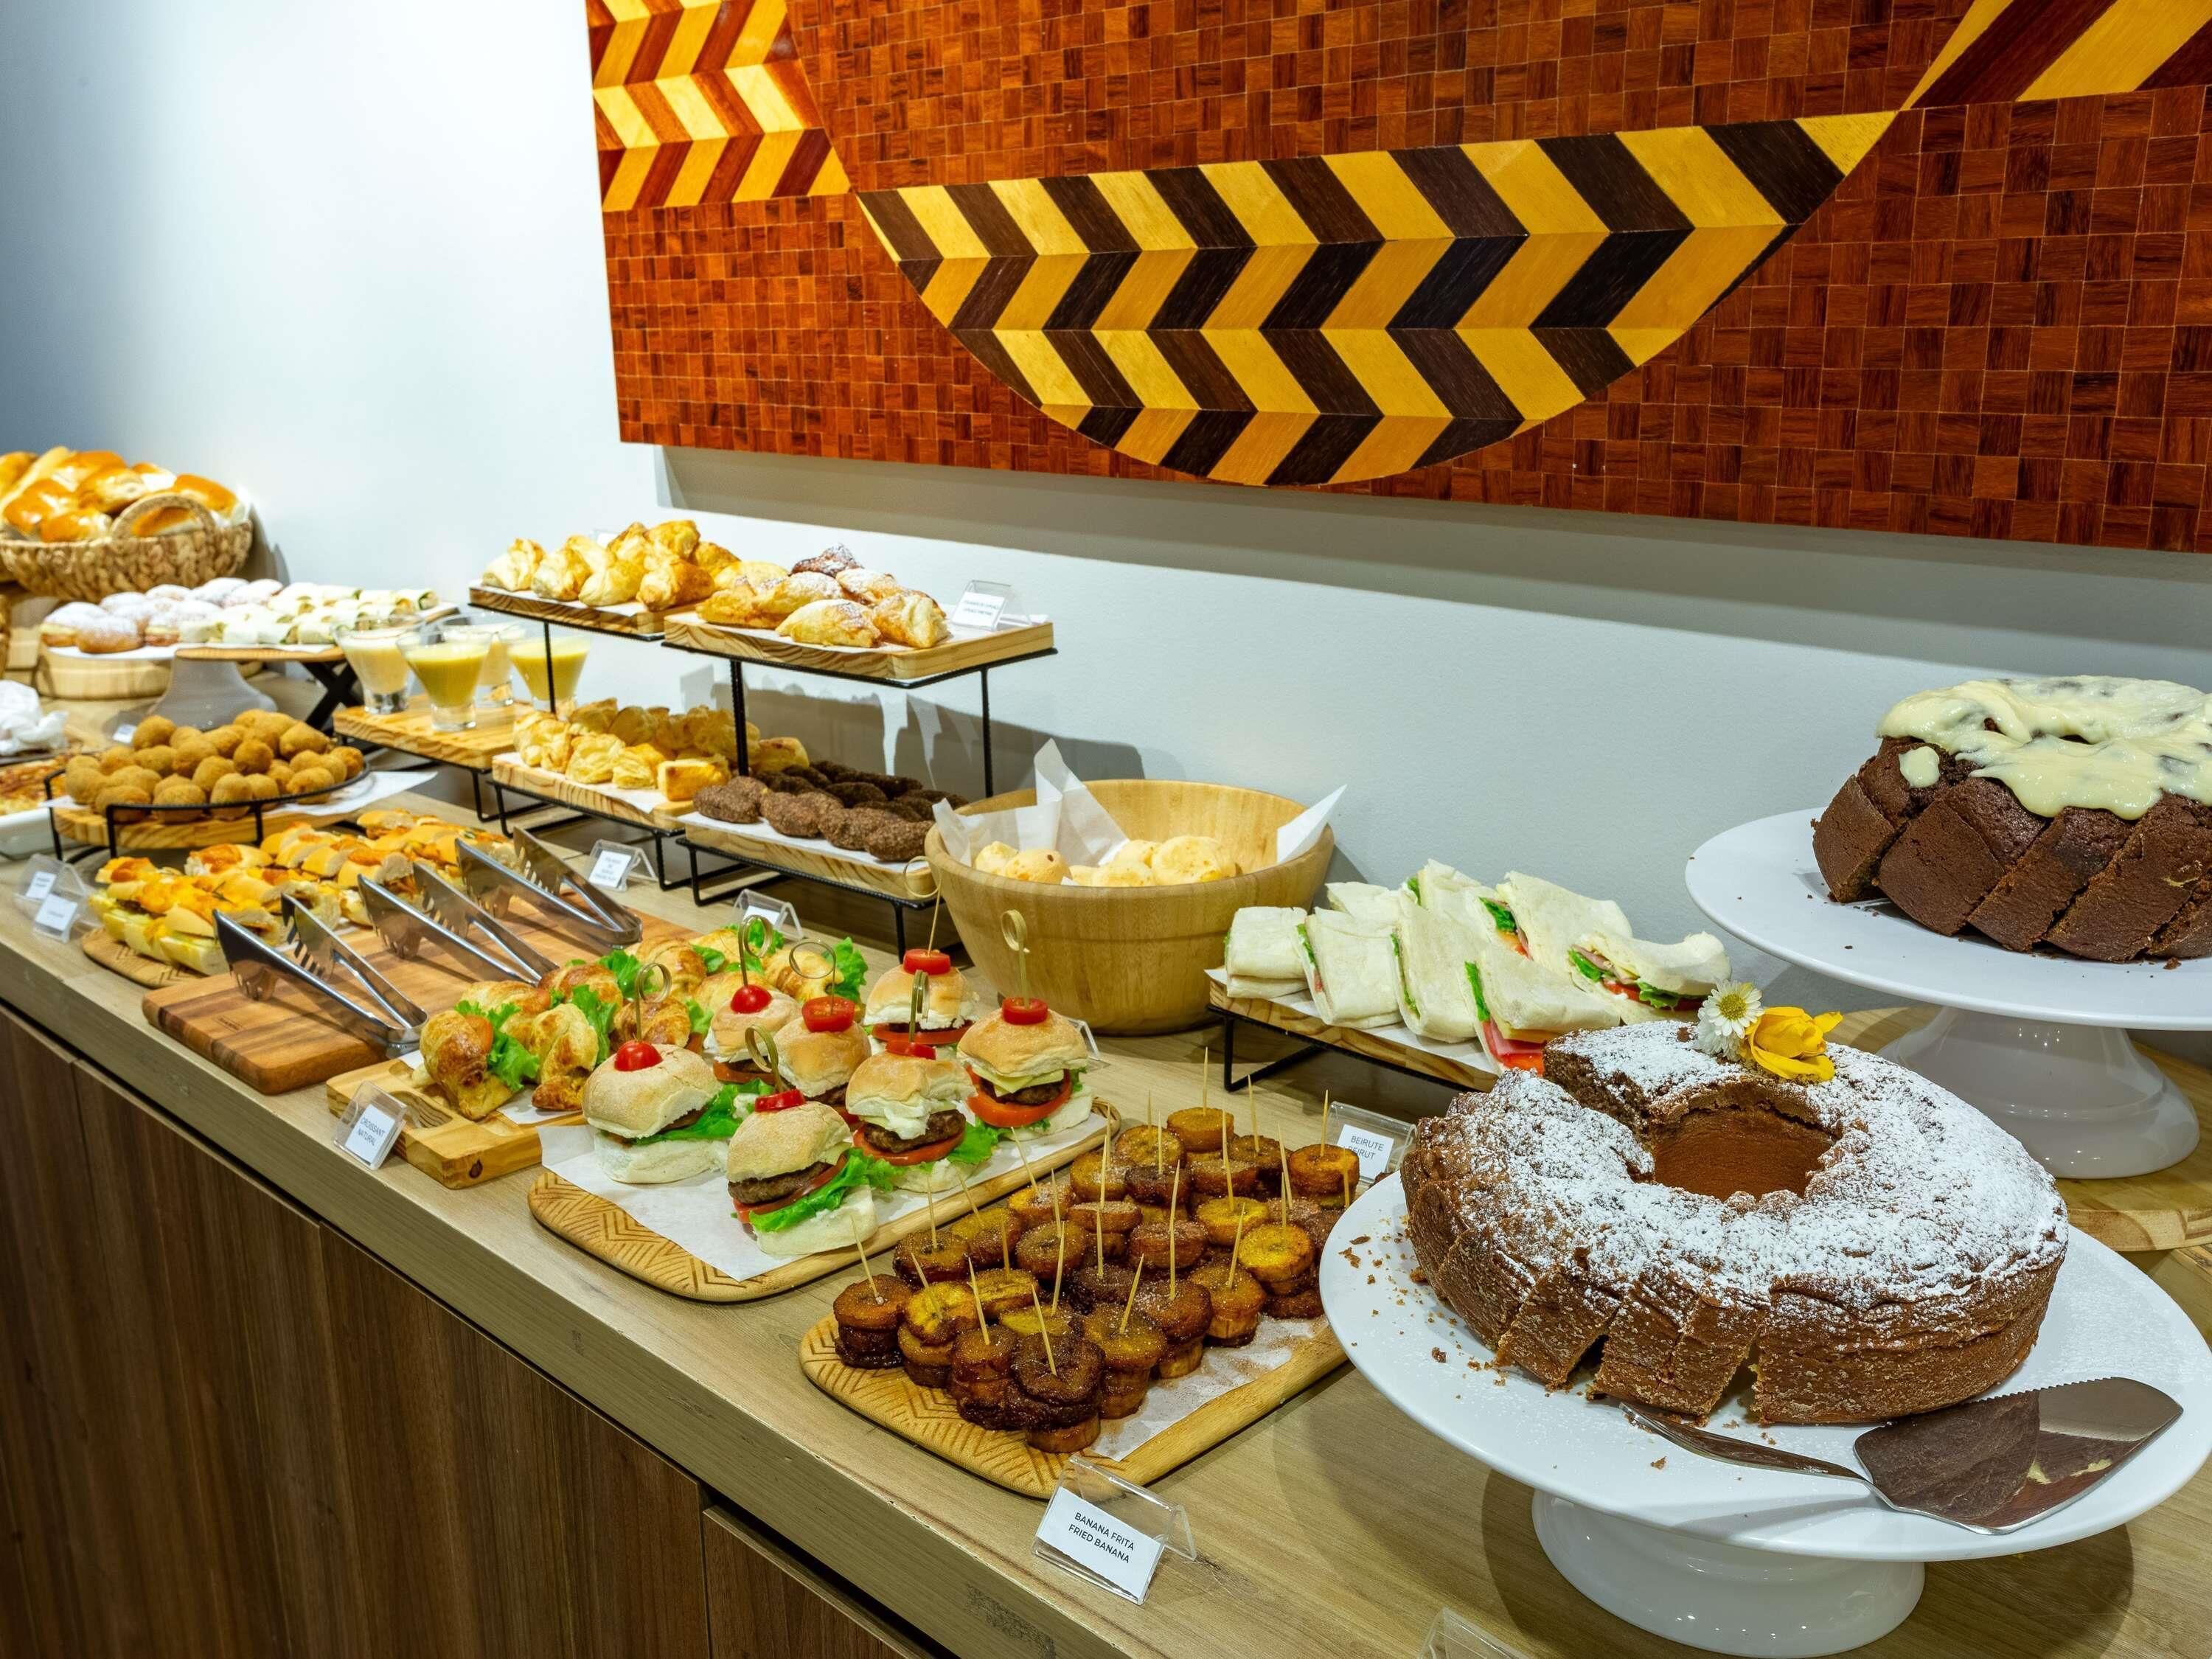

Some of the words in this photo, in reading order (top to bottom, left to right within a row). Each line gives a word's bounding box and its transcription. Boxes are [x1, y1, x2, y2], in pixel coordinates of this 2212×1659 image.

[1351, 1135, 1384, 1151] BEIRUTE
[1068, 1523, 1093, 1543] FRIED
[1094, 1538, 1130, 1563] BANANA
[1074, 1512, 1110, 1536] BANANA
[1111, 1532, 1135, 1551] FRITA
